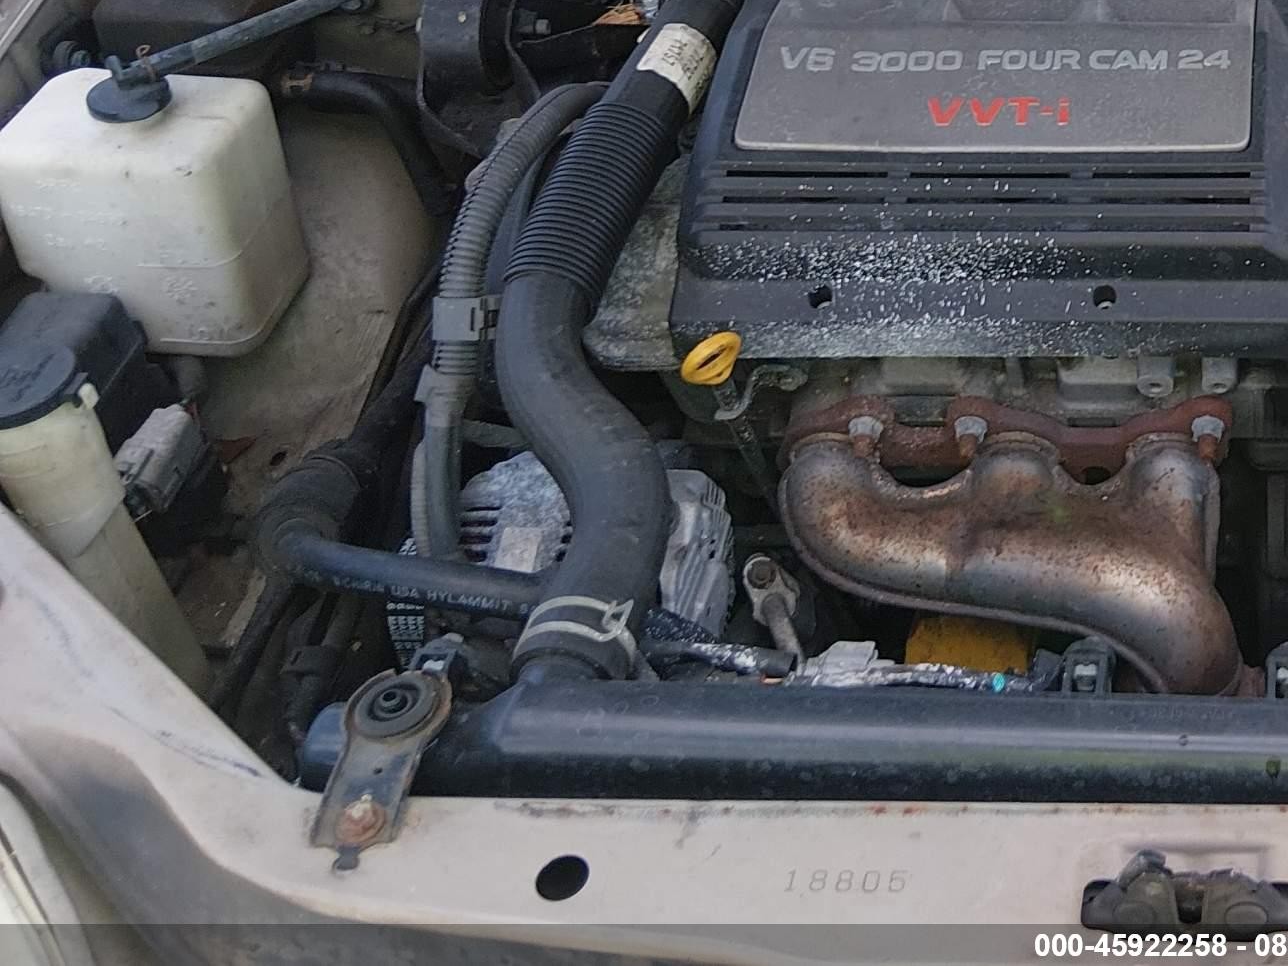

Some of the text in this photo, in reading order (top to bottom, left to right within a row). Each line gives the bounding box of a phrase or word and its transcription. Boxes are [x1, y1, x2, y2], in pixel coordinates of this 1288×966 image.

[780, 46, 1231, 72] V6 3000 FOUR CAM 24
[927, 95, 1071, 127] VVT-i
